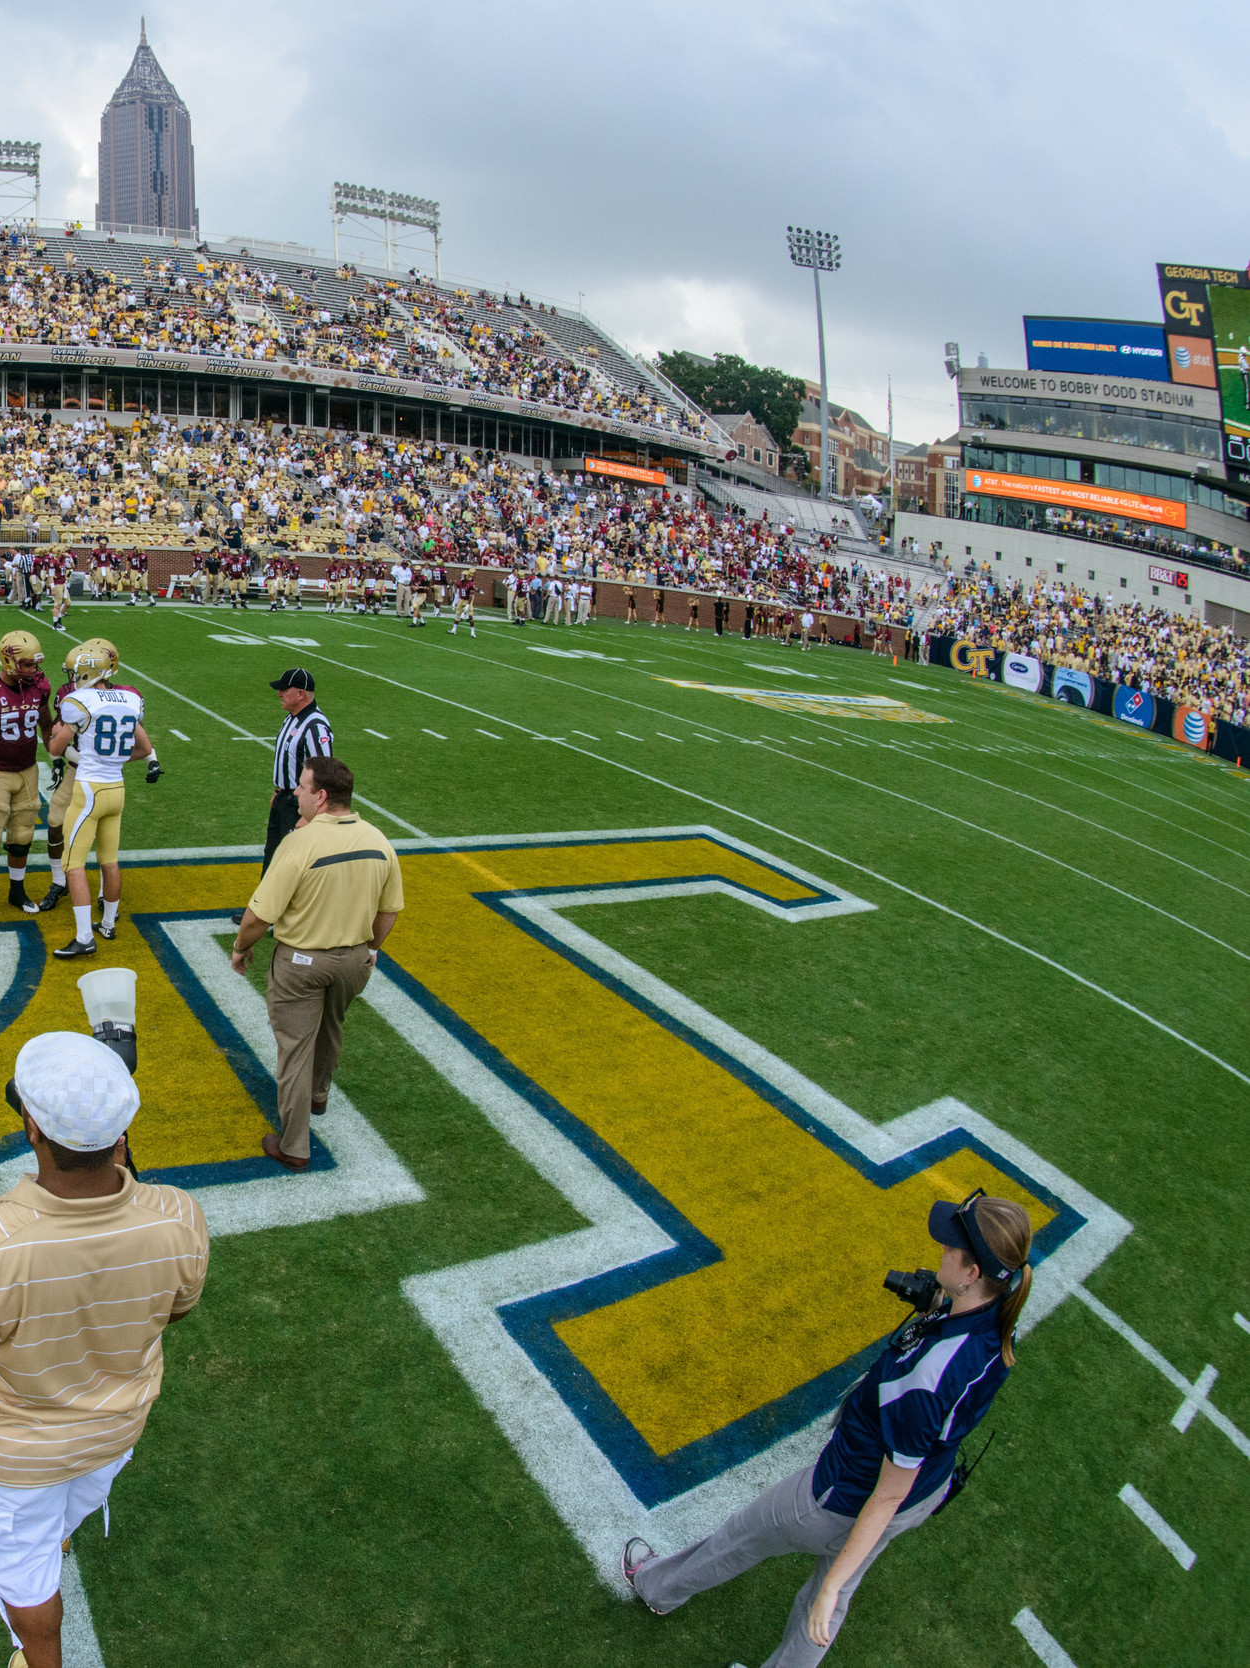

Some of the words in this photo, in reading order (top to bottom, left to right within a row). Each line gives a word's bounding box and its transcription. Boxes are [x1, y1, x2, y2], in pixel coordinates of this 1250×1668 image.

[1165, 266, 1211, 280] GEORGIA
[1211, 270, 1239, 284] TECH
[1164, 290, 1204, 326] GT
[1132, 346, 1163, 357] HYUNDAI
[52, 355, 115, 365] STRUPPER
[136, 359, 189, 370] FINCHER
[207, 359, 239, 367] WILLIAM
[1192, 354, 1212, 367] at&t
[206, 366, 273, 378] ALEXANDER
[359, 376, 386, 385] GEORGE
[358, 382, 407, 395] GARDNER
[980, 376, 1036, 390] WELCOME
[1040, 379, 1056, 391] TO
[1060, 381, 1098, 396] BOBBY
[1103, 384, 1137, 400] DODD
[1140, 388, 1194, 408] STADIUM
[424, 391, 451, 401] DODD
[468, 399, 504, 411] MORRIS
[519, 408, 554, 420] GASTON
[1012, 482, 1034, 491] nation's
[1034, 485, 1060, 494] FASTEST
[1072, 490, 1089, 499] MOST
[1090, 493, 1119, 504] RELIABLE
[1119, 498, 1128, 506] 4G
[1128, 500, 1139, 508] LTE
[1140, 504, 1163, 513] network
[76, 654, 100, 669] GT
[950, 640, 995, 678] GT
[1, 696, 8, 706] C
[97, 691, 127, 703] POOLE
[1, 704, 40, 713] ELON
[0, 710, 40, 741] 59
[94, 714, 137, 756] 82
